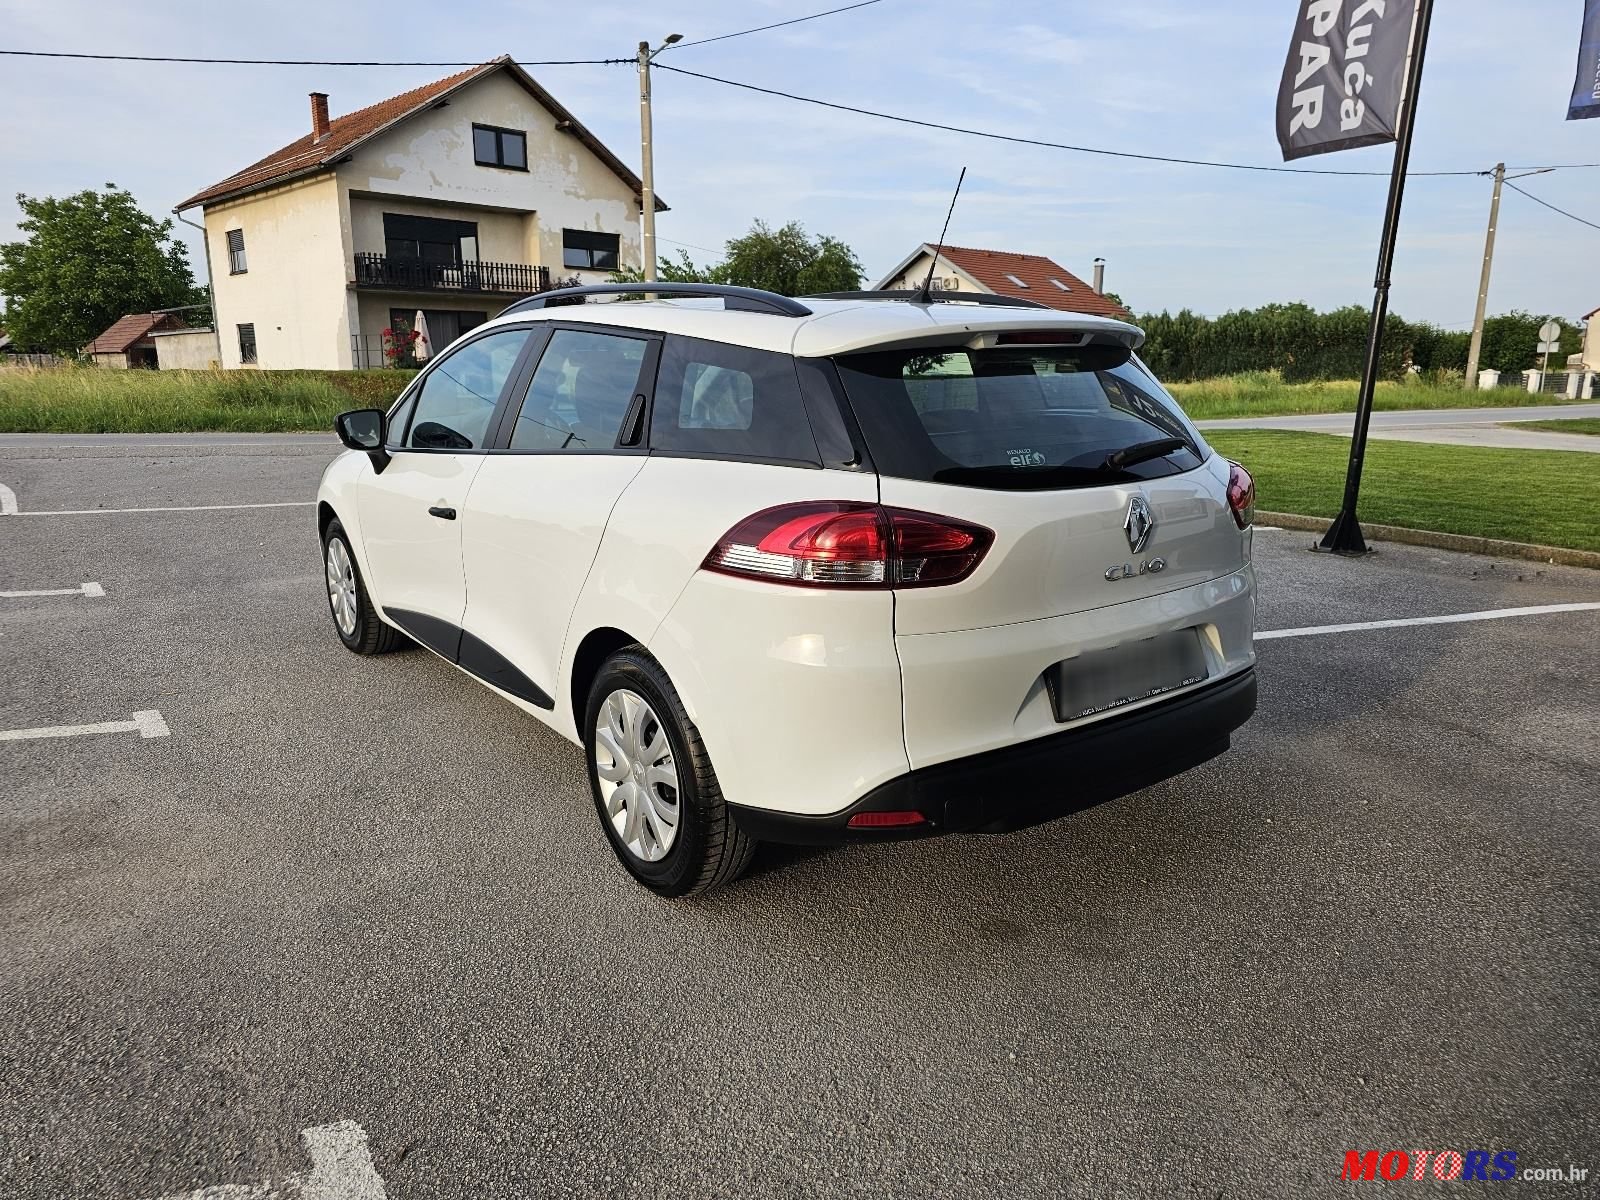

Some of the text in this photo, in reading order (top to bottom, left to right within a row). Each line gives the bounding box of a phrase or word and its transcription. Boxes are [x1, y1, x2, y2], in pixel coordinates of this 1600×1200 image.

[1290, 0, 1343, 137] PAR
[1010, 454, 1032, 466] elf
[1104, 557, 1165, 581] CLIO
